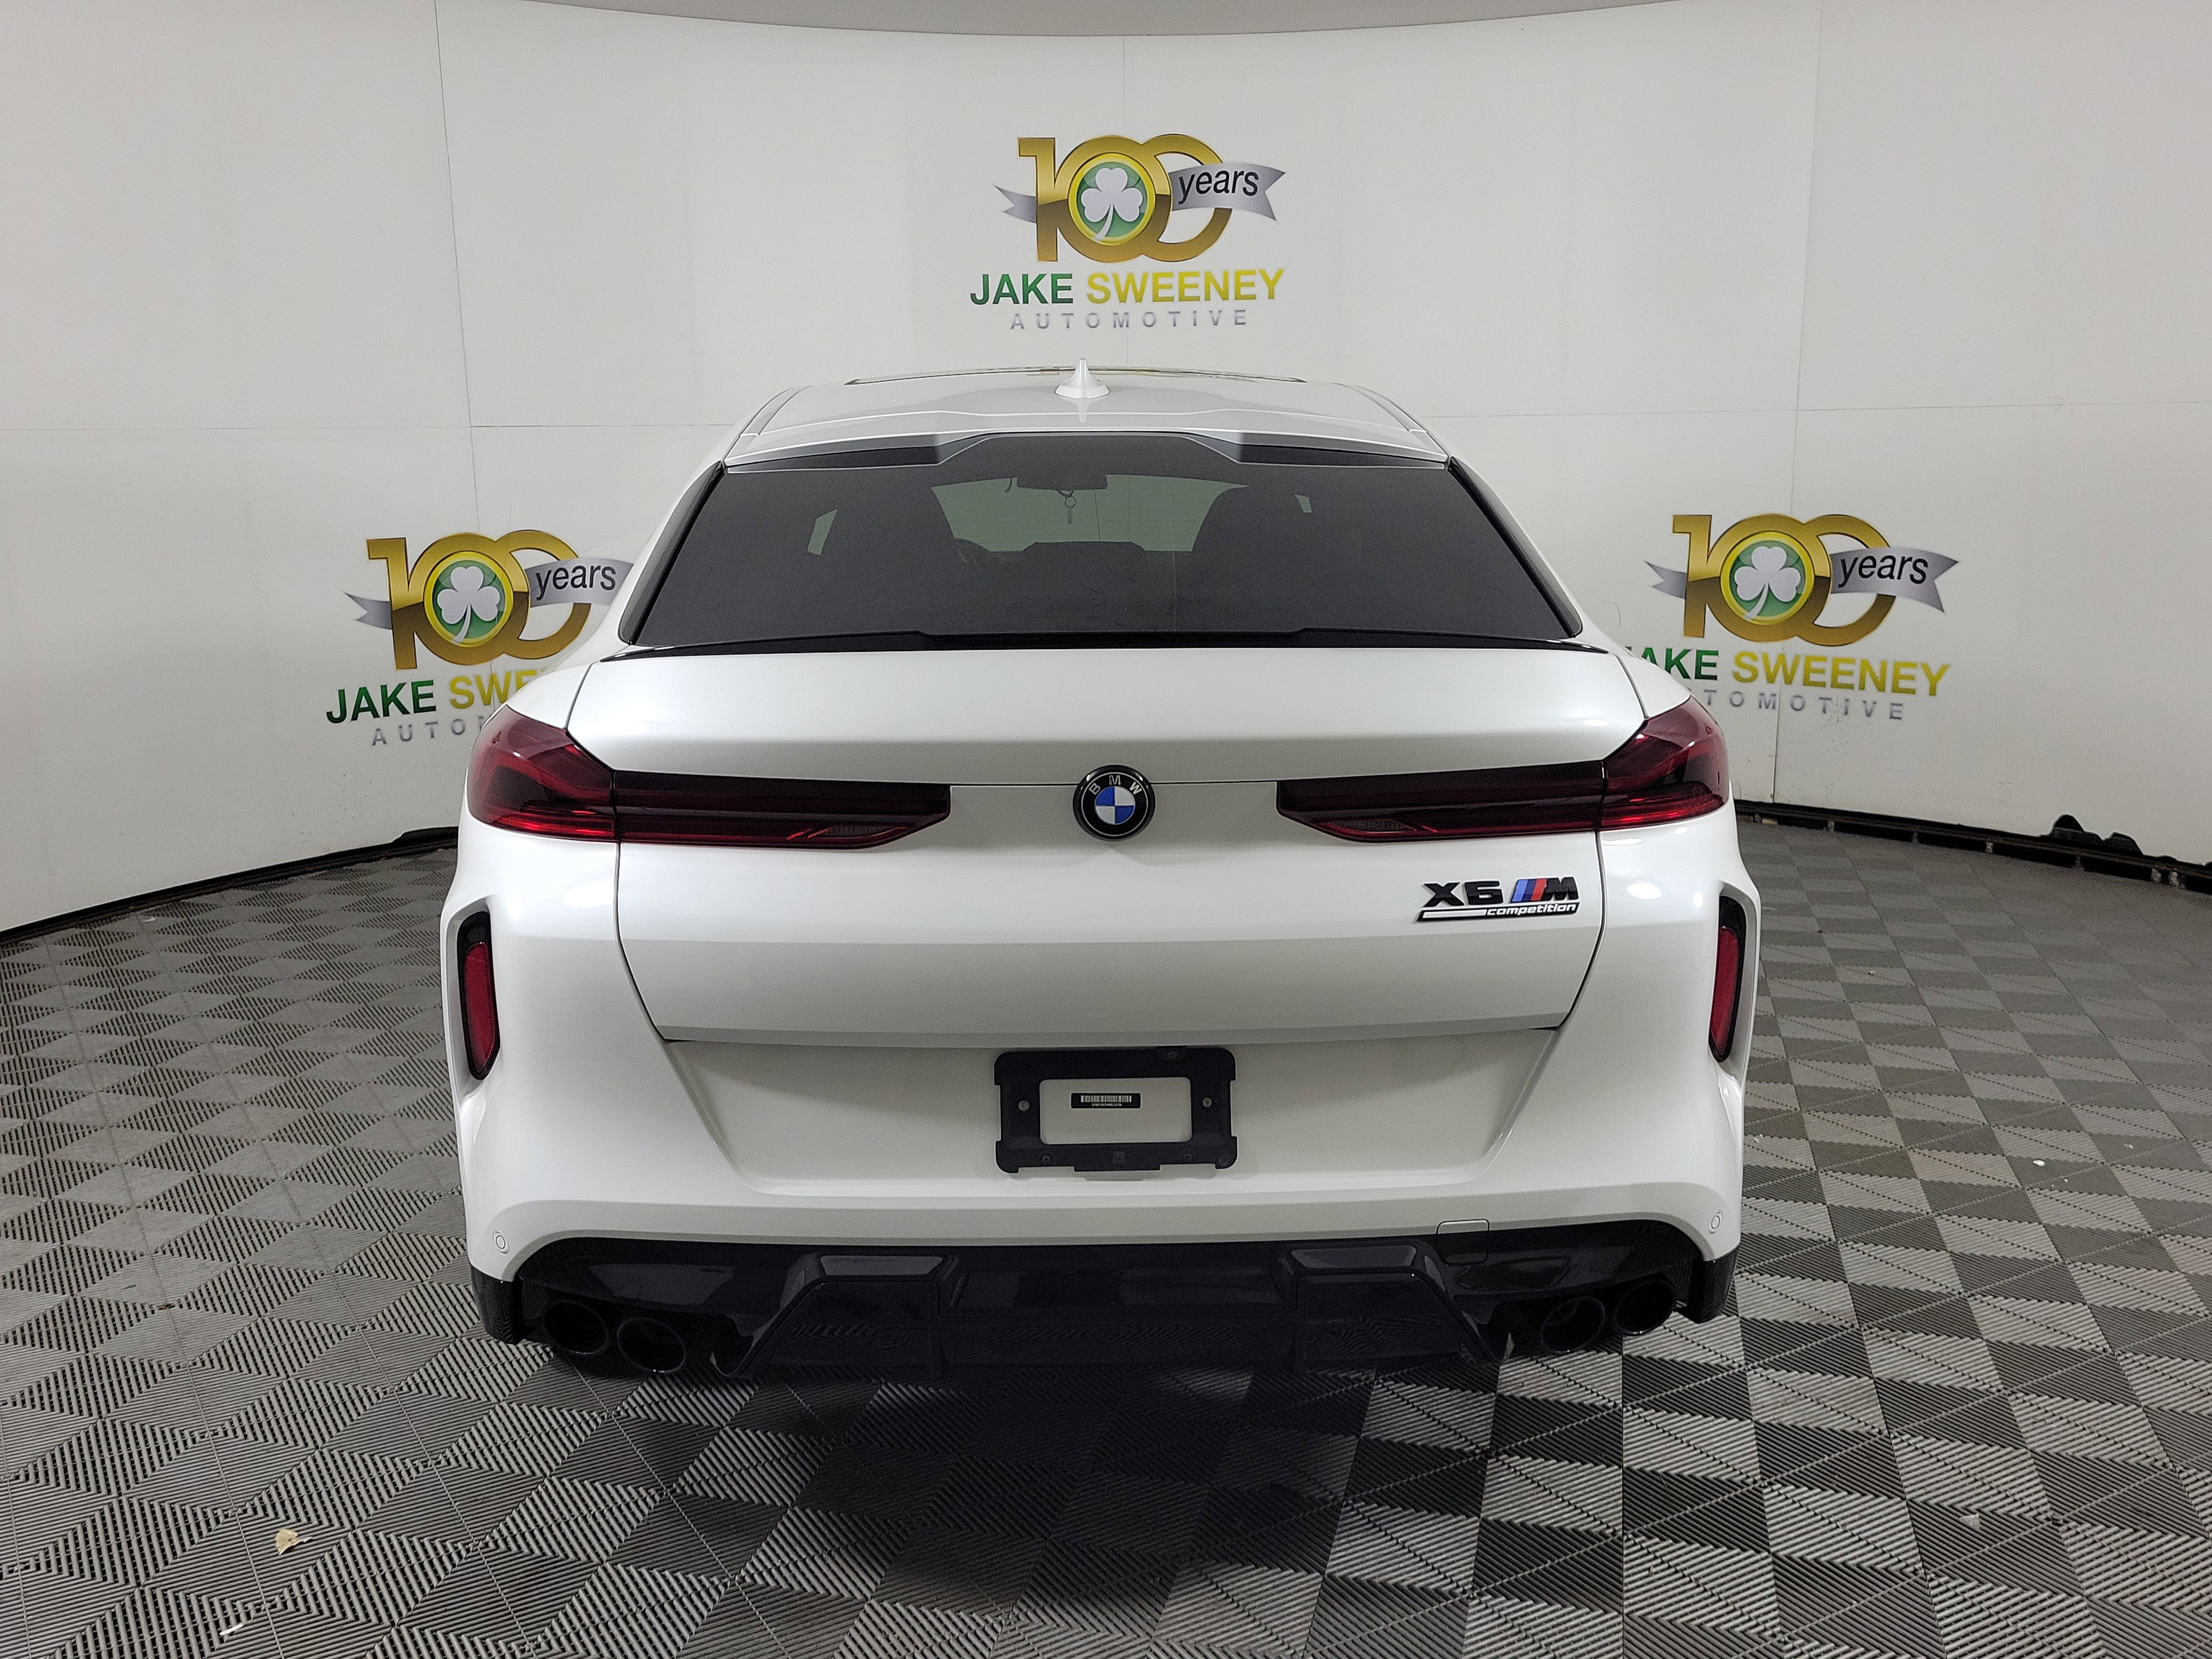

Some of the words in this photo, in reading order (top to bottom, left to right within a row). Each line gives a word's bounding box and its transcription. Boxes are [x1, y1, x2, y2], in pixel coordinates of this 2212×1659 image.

[1018, 134, 1232, 263] 100
[1178, 167, 1259, 205] years
[970, 273, 1073, 305] JAKE
[1086, 268, 1284, 304] SWEENEY
[1011, 309, 1246, 330] AUTOMOTIVE
[1672, 514, 1897, 646] 100
[1838, 554, 1928, 588] years
[366, 529, 591, 670] 100
[535, 564, 616, 601] years
[1732, 650, 1950, 696] SWEENEY
[326, 679, 437, 724] JAKE
[449, 669, 544, 709] SWE
[1689, 688, 1903, 720] TOMOTIVE
[372, 715, 484, 746] AUTO
[1088, 775, 1142, 795] BMW
[1423, 880, 1504, 907] X6
[1487, 903, 1576, 916] competition
